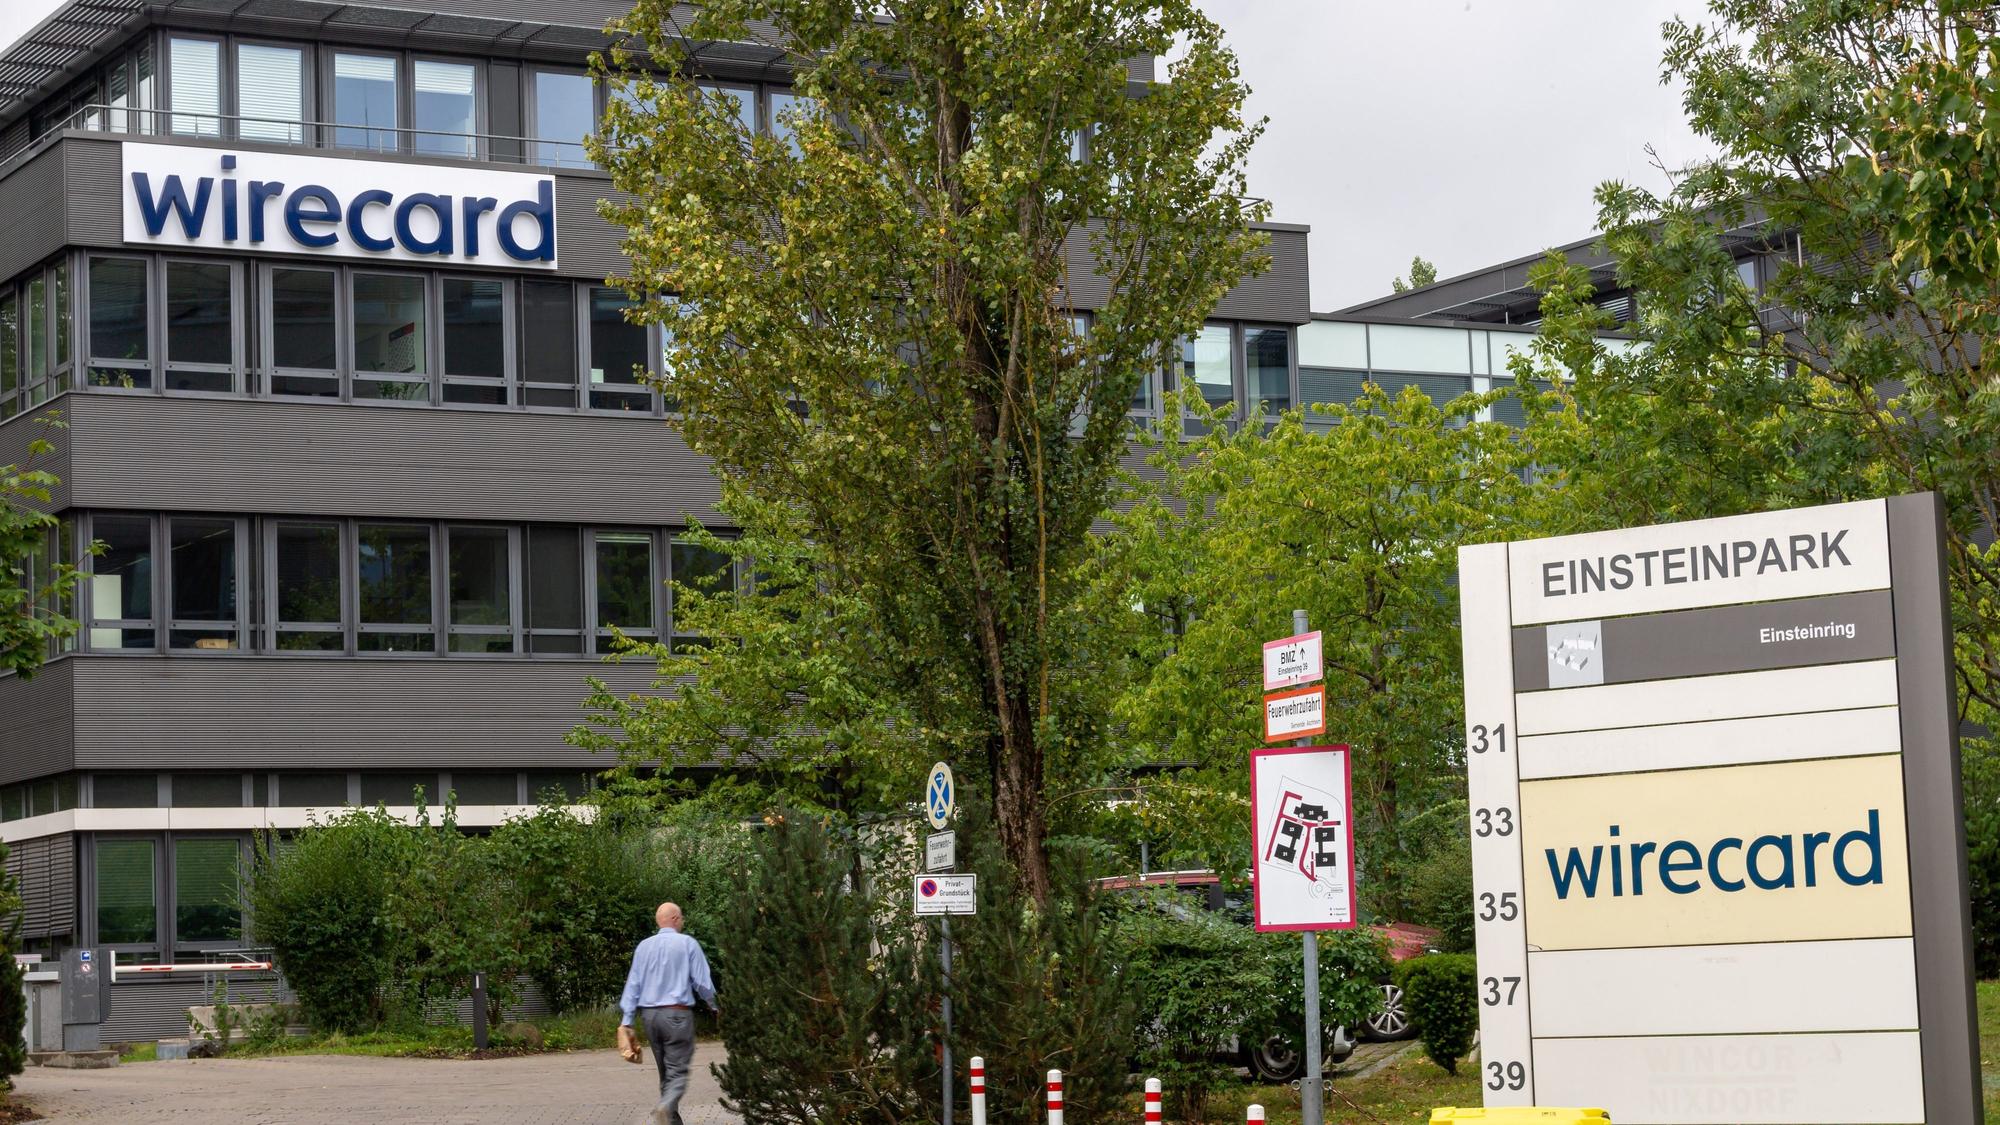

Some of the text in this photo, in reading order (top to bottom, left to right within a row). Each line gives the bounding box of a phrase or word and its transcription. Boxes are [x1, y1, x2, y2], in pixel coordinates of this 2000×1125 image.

[131, 155, 555, 262] wirecard
[1542, 529, 1851, 598] EINSTEINPARK
[1759, 621, 1856, 644] Einsteinring
[1280, 650, 1296, 664] BMZ
[1268, 697, 1321, 719] Feuerwehrzufahrt
[1472, 723, 1506, 754] 31
[1475, 807, 1514, 838] 33
[1545, 809, 1883, 900] wirecard
[939, 889, 970, 897] Grundstück
[1479, 892, 1518, 922] 35
[1482, 977, 1521, 1006] 37
[1645, 1044, 1795, 1071] WINCOR
[1487, 1060, 1526, 1091] 39
[1648, 1087, 1799, 1115] NIXDORF
